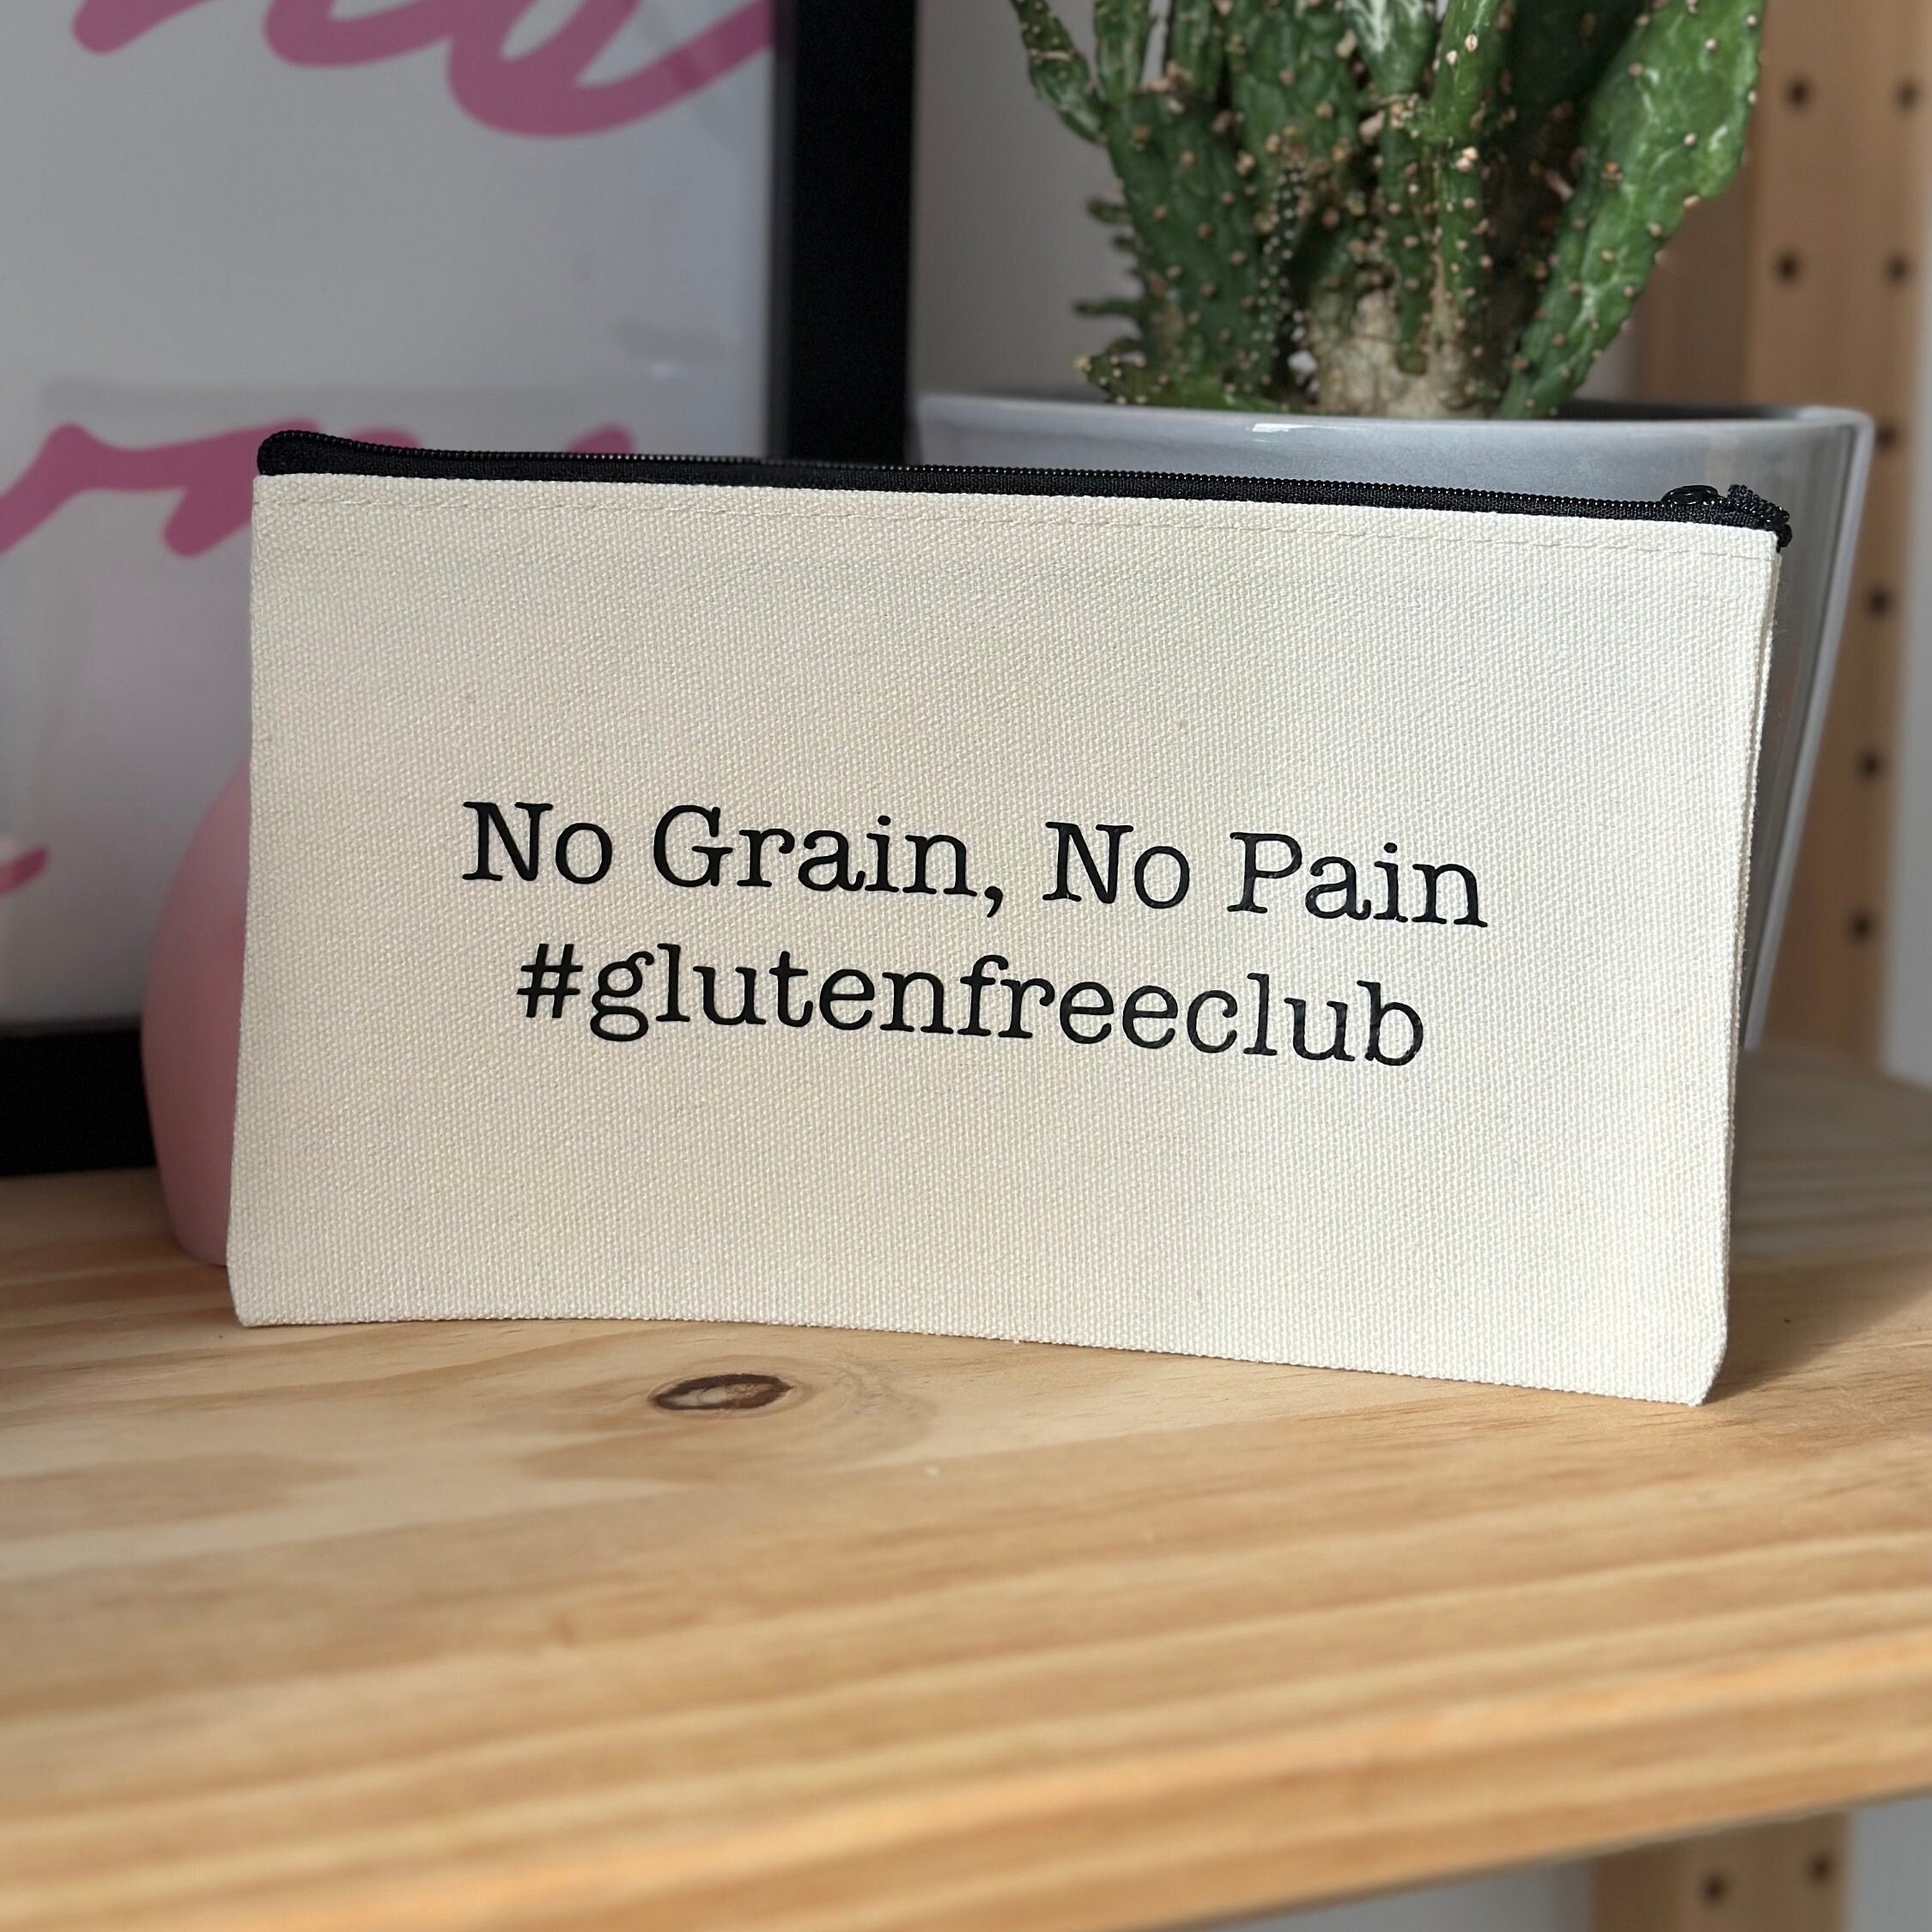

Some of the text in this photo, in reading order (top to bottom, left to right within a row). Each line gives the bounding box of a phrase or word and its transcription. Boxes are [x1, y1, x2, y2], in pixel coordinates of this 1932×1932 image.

[461, 801, 1488, 928] No Grain, No Pain
[516, 942, 1424, 1066] #glutenfreeclub
